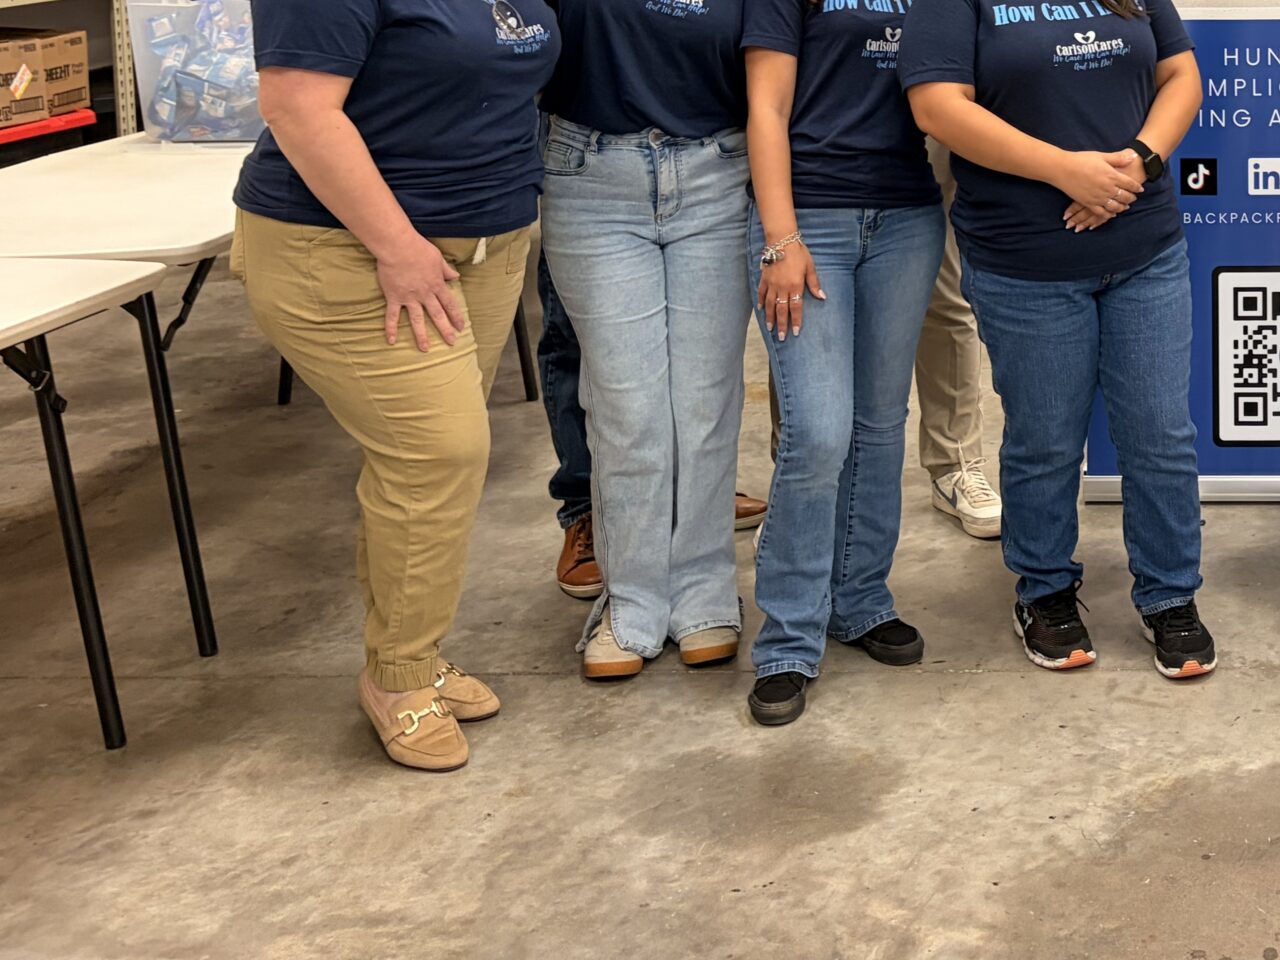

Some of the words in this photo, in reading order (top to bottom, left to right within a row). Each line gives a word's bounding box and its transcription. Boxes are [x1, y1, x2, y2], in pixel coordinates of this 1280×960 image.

[992, 4, 1036, 26] How
[1040, 2, 1080, 21] Can
[1079, 1, 1095, 18] I
[1055, 38, 1124, 56] CarlsonCares
[1199, 109, 1252, 127] ING
